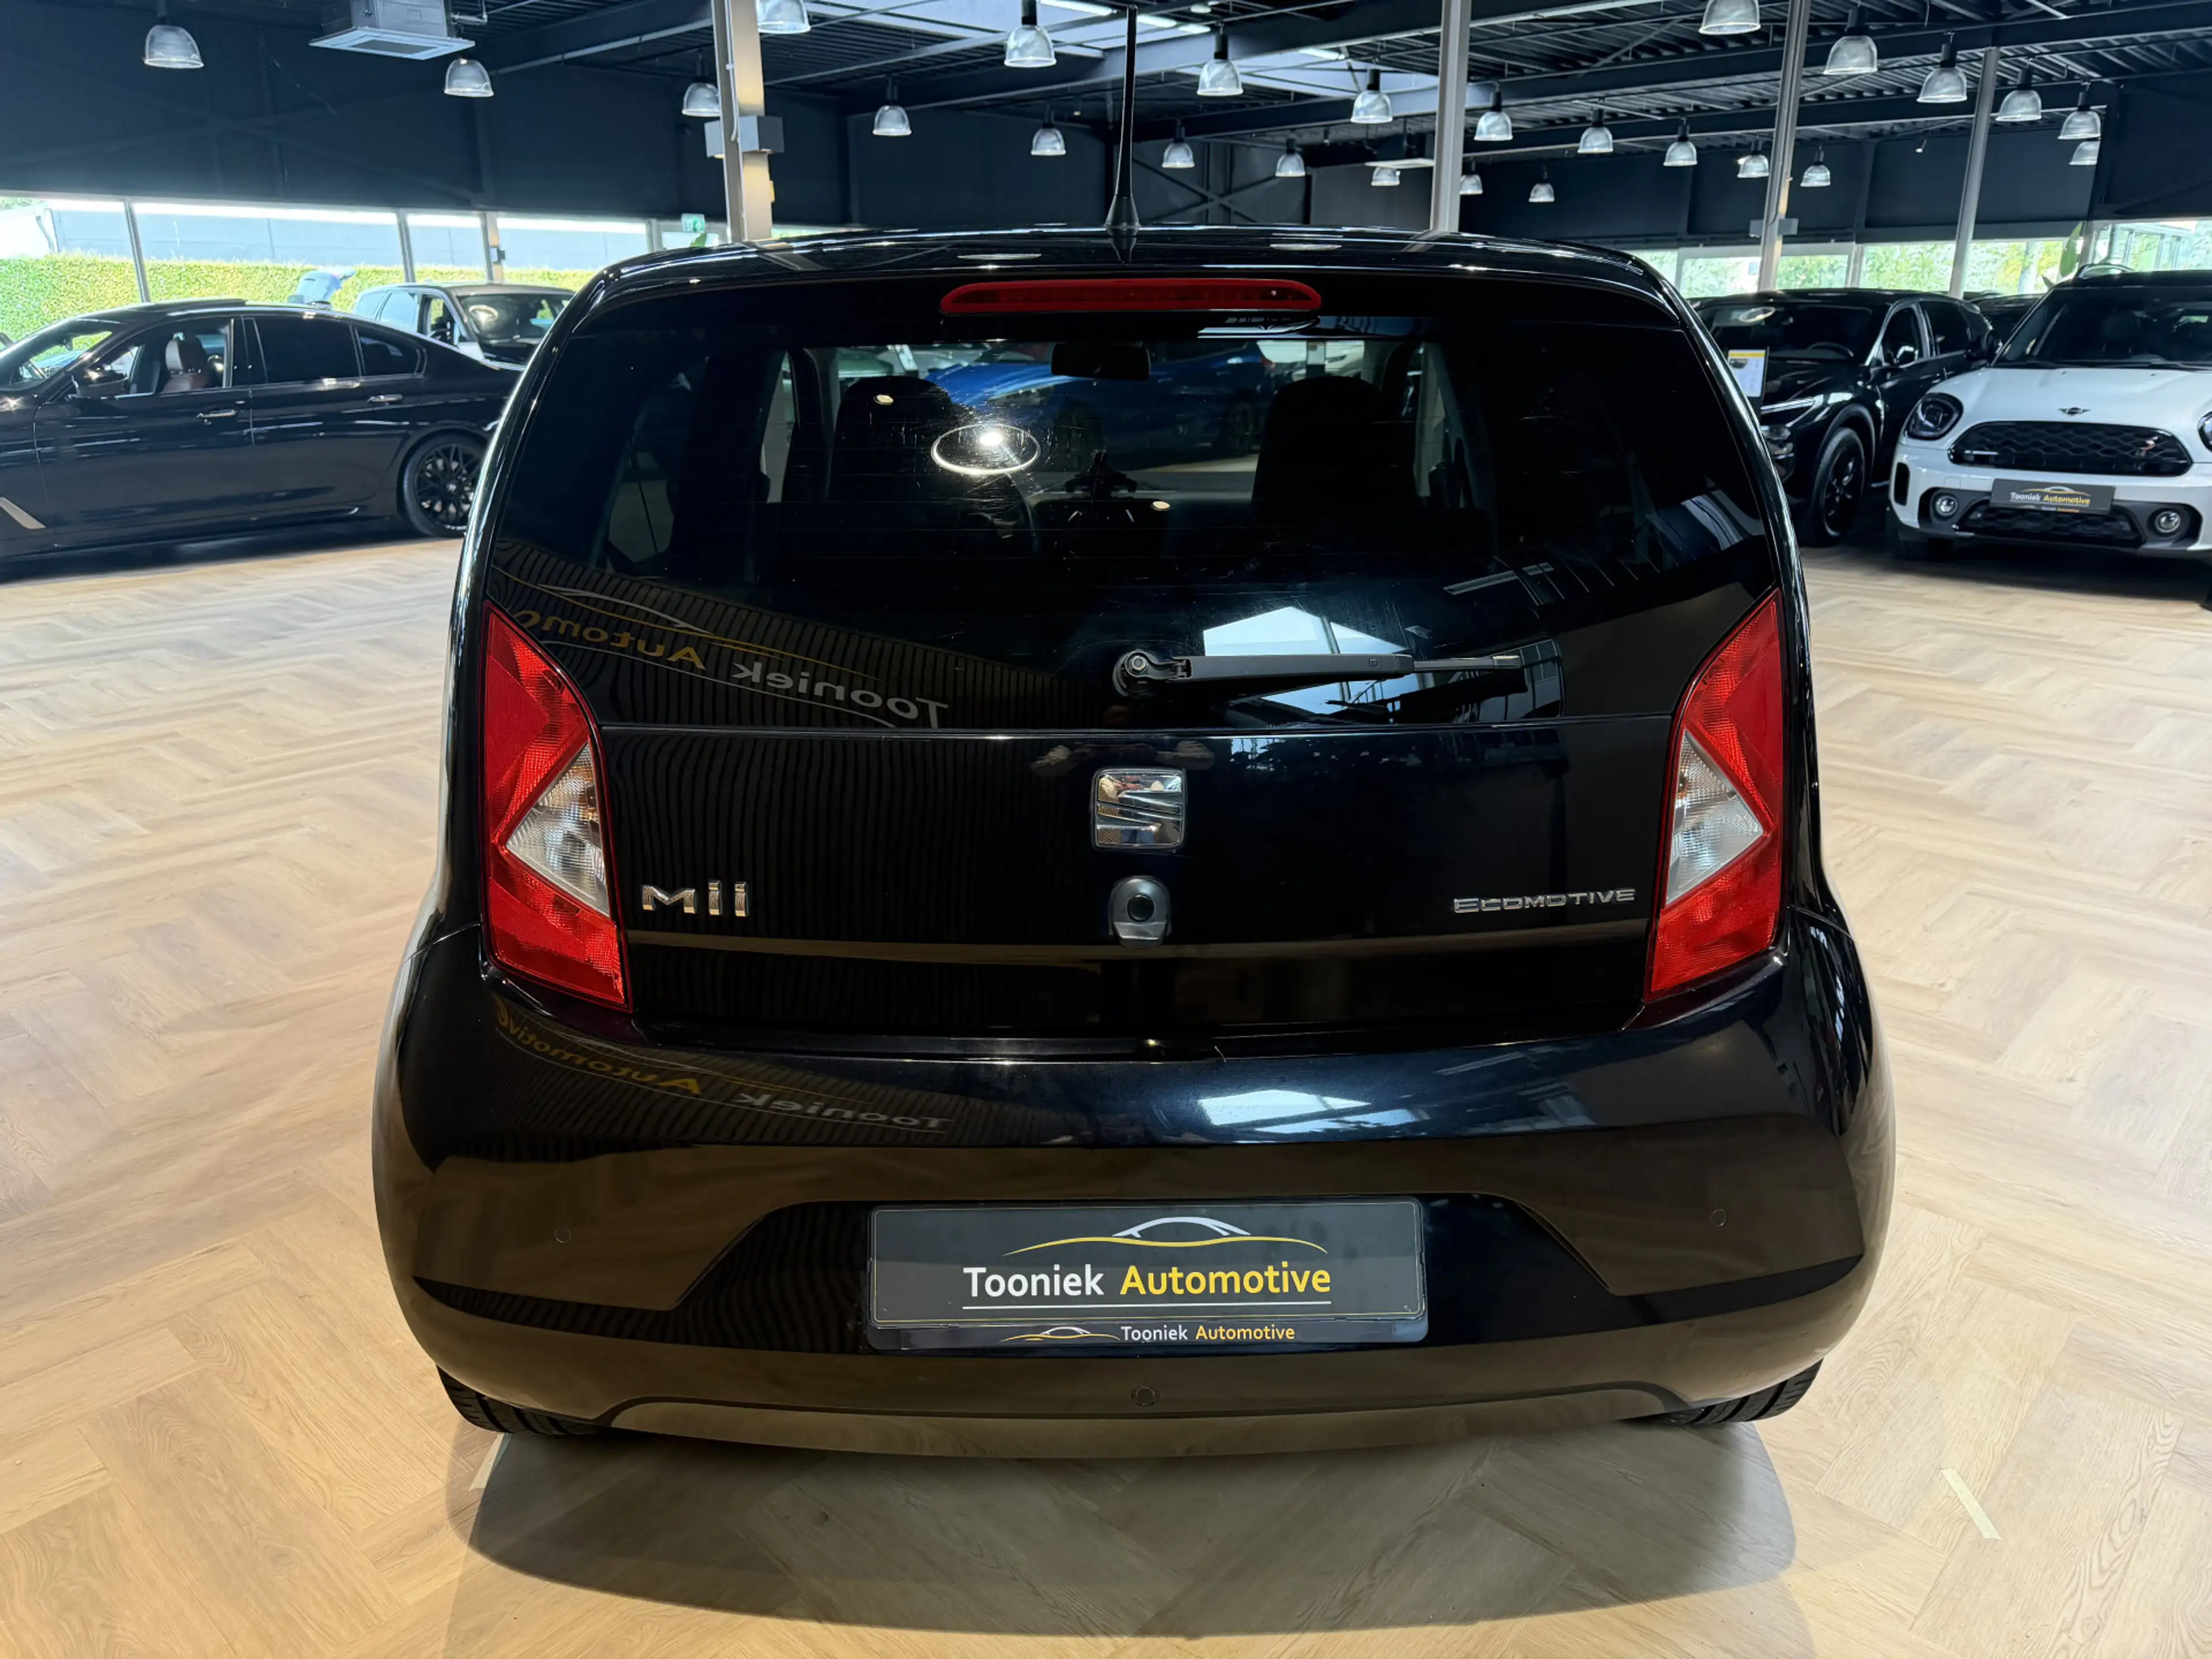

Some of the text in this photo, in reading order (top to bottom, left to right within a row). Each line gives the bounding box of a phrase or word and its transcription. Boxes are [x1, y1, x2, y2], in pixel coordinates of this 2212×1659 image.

[2010, 491, 2090, 504] Tooniek Automotive
[642, 880, 749, 917] Mii
[1453, 889, 1635, 914] ECOMOTIVE
[963, 1261, 1331, 1297] Tooniek Automotive
[1120, 1324, 1296, 1341] Tooniek Automotive
